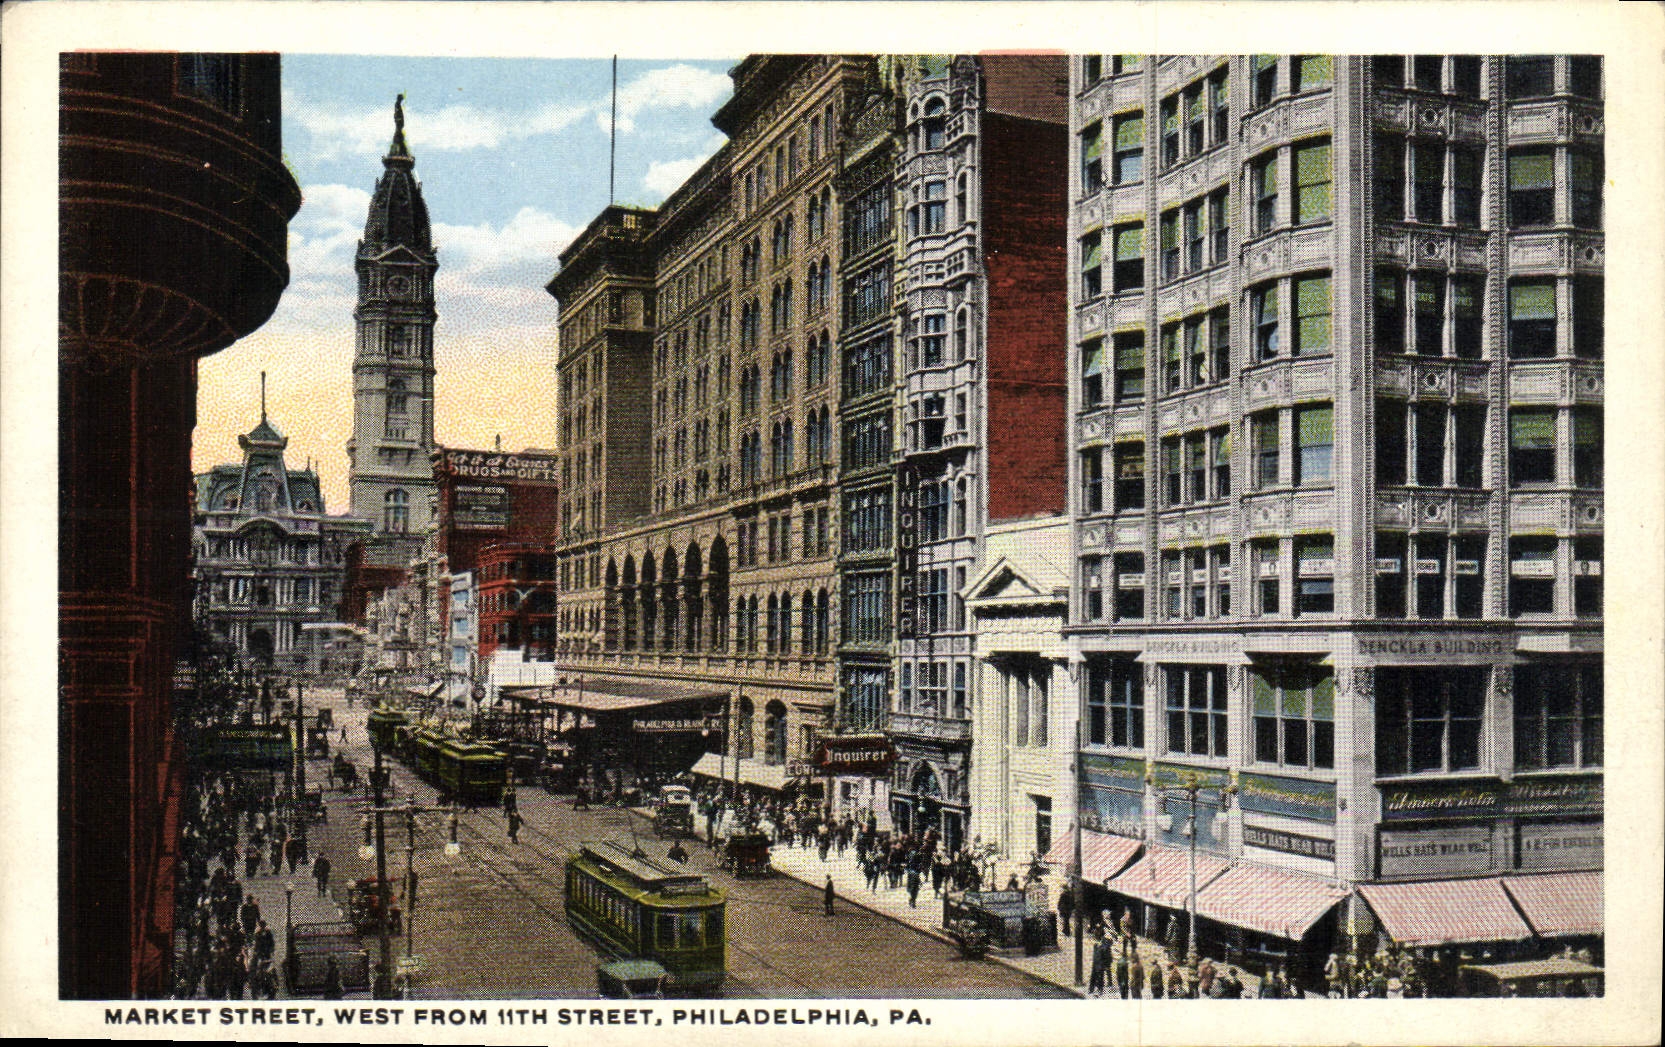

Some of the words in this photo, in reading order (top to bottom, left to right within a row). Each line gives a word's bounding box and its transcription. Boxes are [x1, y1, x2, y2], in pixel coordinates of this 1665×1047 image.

[449, 465, 500, 478] DRUGS
[901, 471, 914, 634] INQUIRER
[1358, 640, 1427, 654] DENCKLA
[1434, 640, 1503, 655] BUILDING
[825, 748, 888, 766] Inquirer
